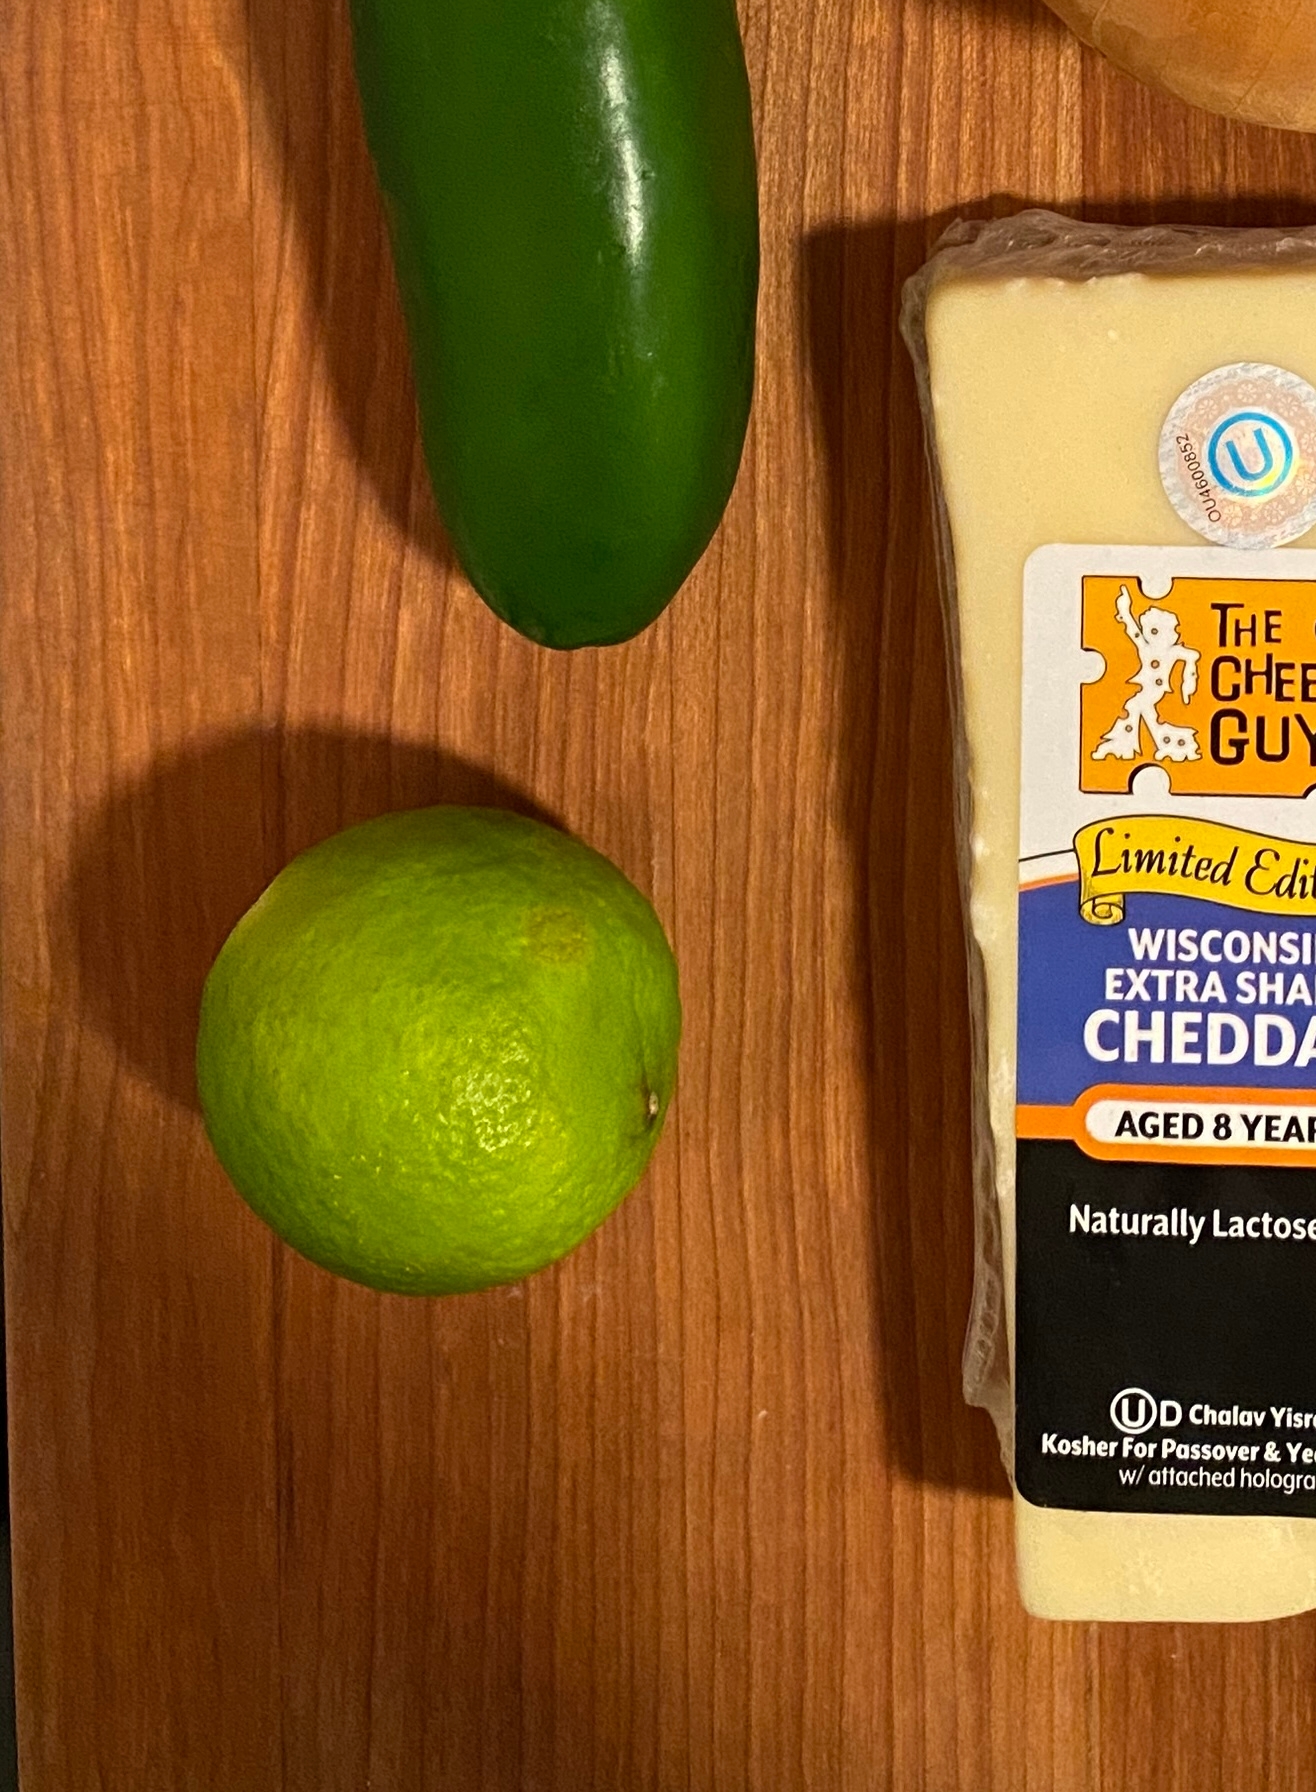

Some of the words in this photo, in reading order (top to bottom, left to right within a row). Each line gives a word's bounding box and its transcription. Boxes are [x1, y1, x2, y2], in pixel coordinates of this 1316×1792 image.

[1091, 827, 1240, 887] Limited
[1104, 968, 1228, 1003] EXTRA
[1115, 1110, 1204, 1140] AGED
[1212, 1113, 1232, 1140] 8
[1069, 1204, 1203, 1245] Naturally
[1189, 1404, 1266, 1428] Chalav
[1041, 1433, 1119, 1457] Kosher
[1122, 1437, 1157, 1459] For
[1161, 1438, 1260, 1462] Passover
[1263, 1442, 1281, 1462] &
[1118, 1465, 1146, 1487] w/
[1148, 1466, 1236, 1488] attached
